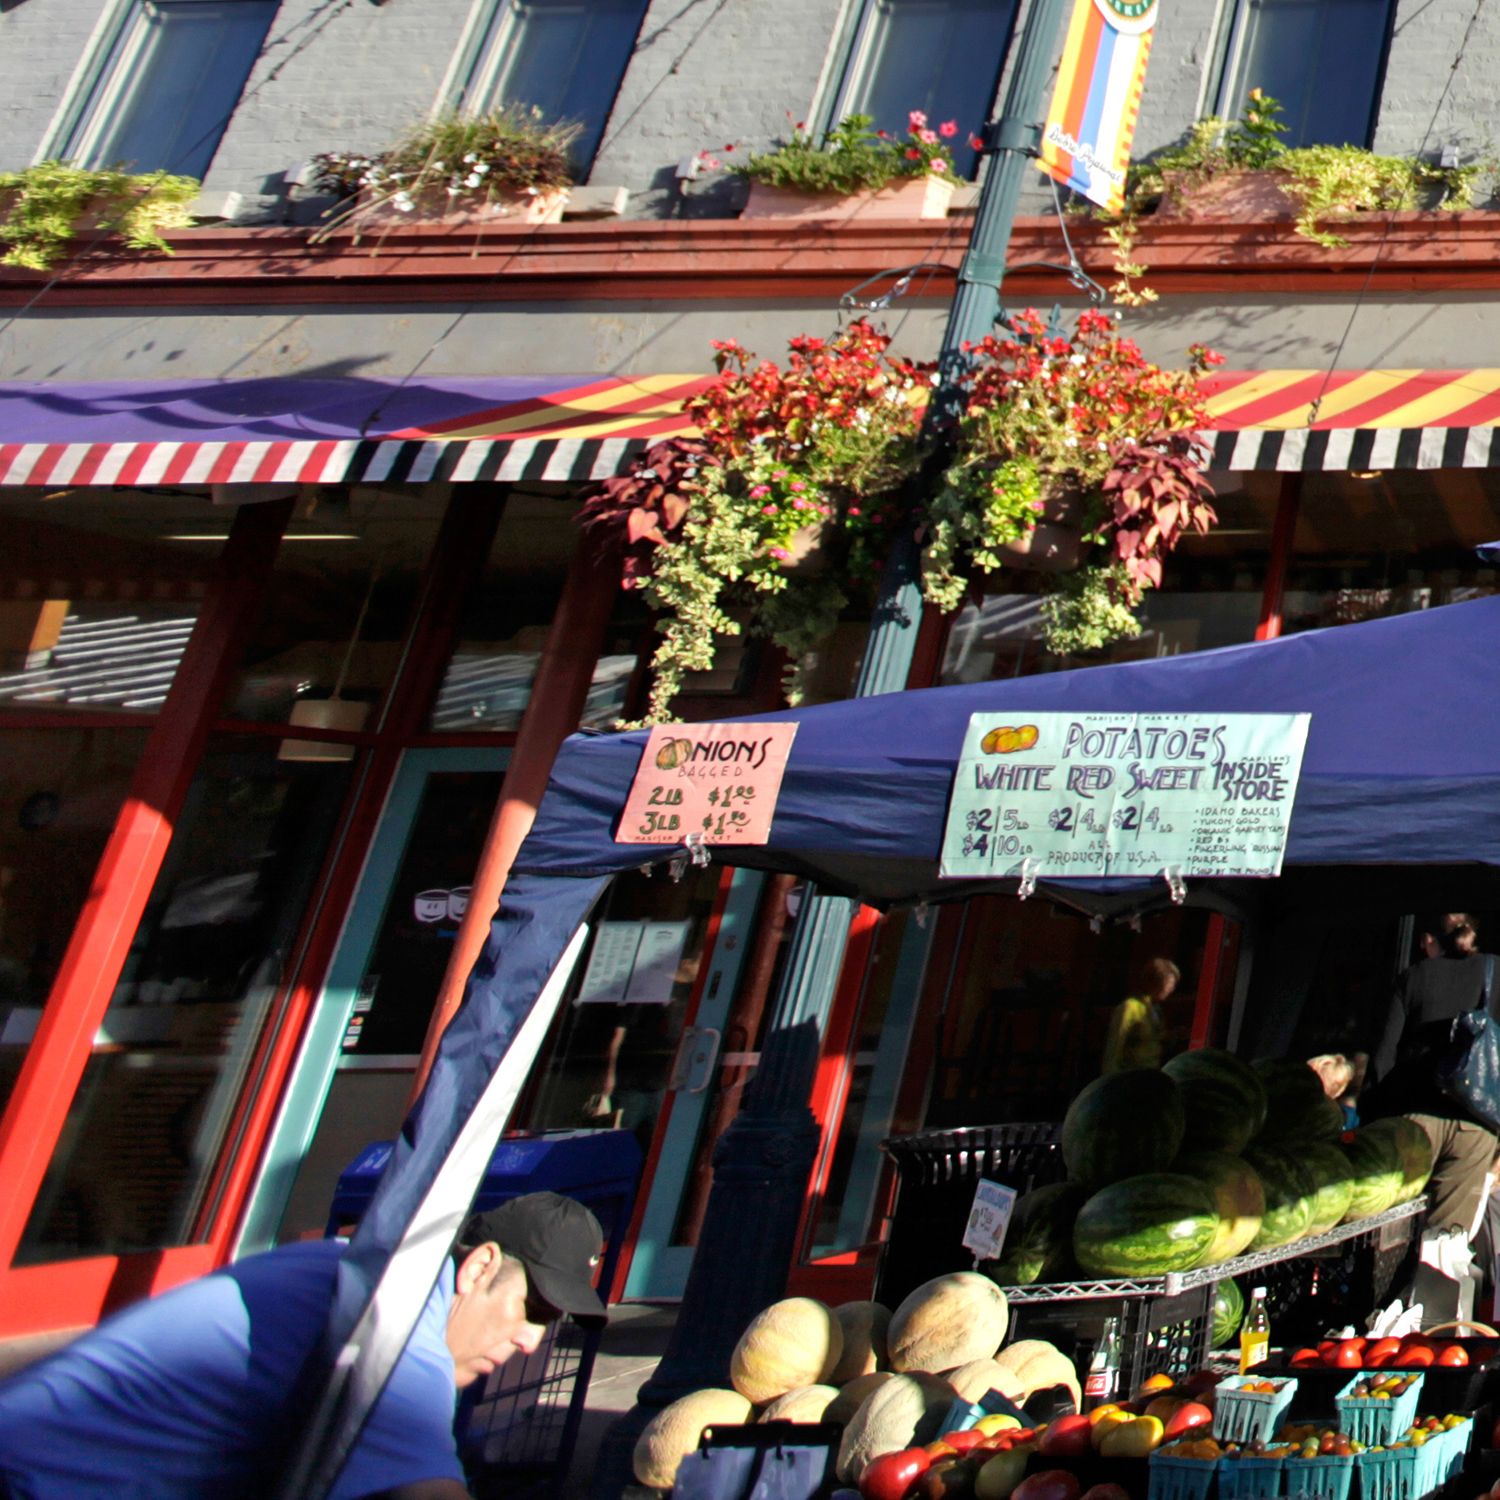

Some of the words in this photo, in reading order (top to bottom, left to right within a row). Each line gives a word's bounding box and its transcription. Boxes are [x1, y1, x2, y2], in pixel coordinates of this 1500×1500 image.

[1062, 722, 1227, 766] POTATOES
[678, 766, 743, 778] BAGGED
[975, 763, 1056, 791] WHITE
[1066, 764, 1116, 799] RED
[1122, 762, 1206, 799] SWEET
[1212, 762, 1284, 791] INSIDE
[1222, 779, 1289, 802] STORE
[1200, 807, 1235, 816] IDAHO
[1241, 806, 1281, 817] BAKERS
[1236, 817, 1260, 825] GOLD
[1088, 840, 1111, 849] ALL
[1047, 851, 1105, 871] PRODUCT
[1105, 851, 1120, 866] OF
